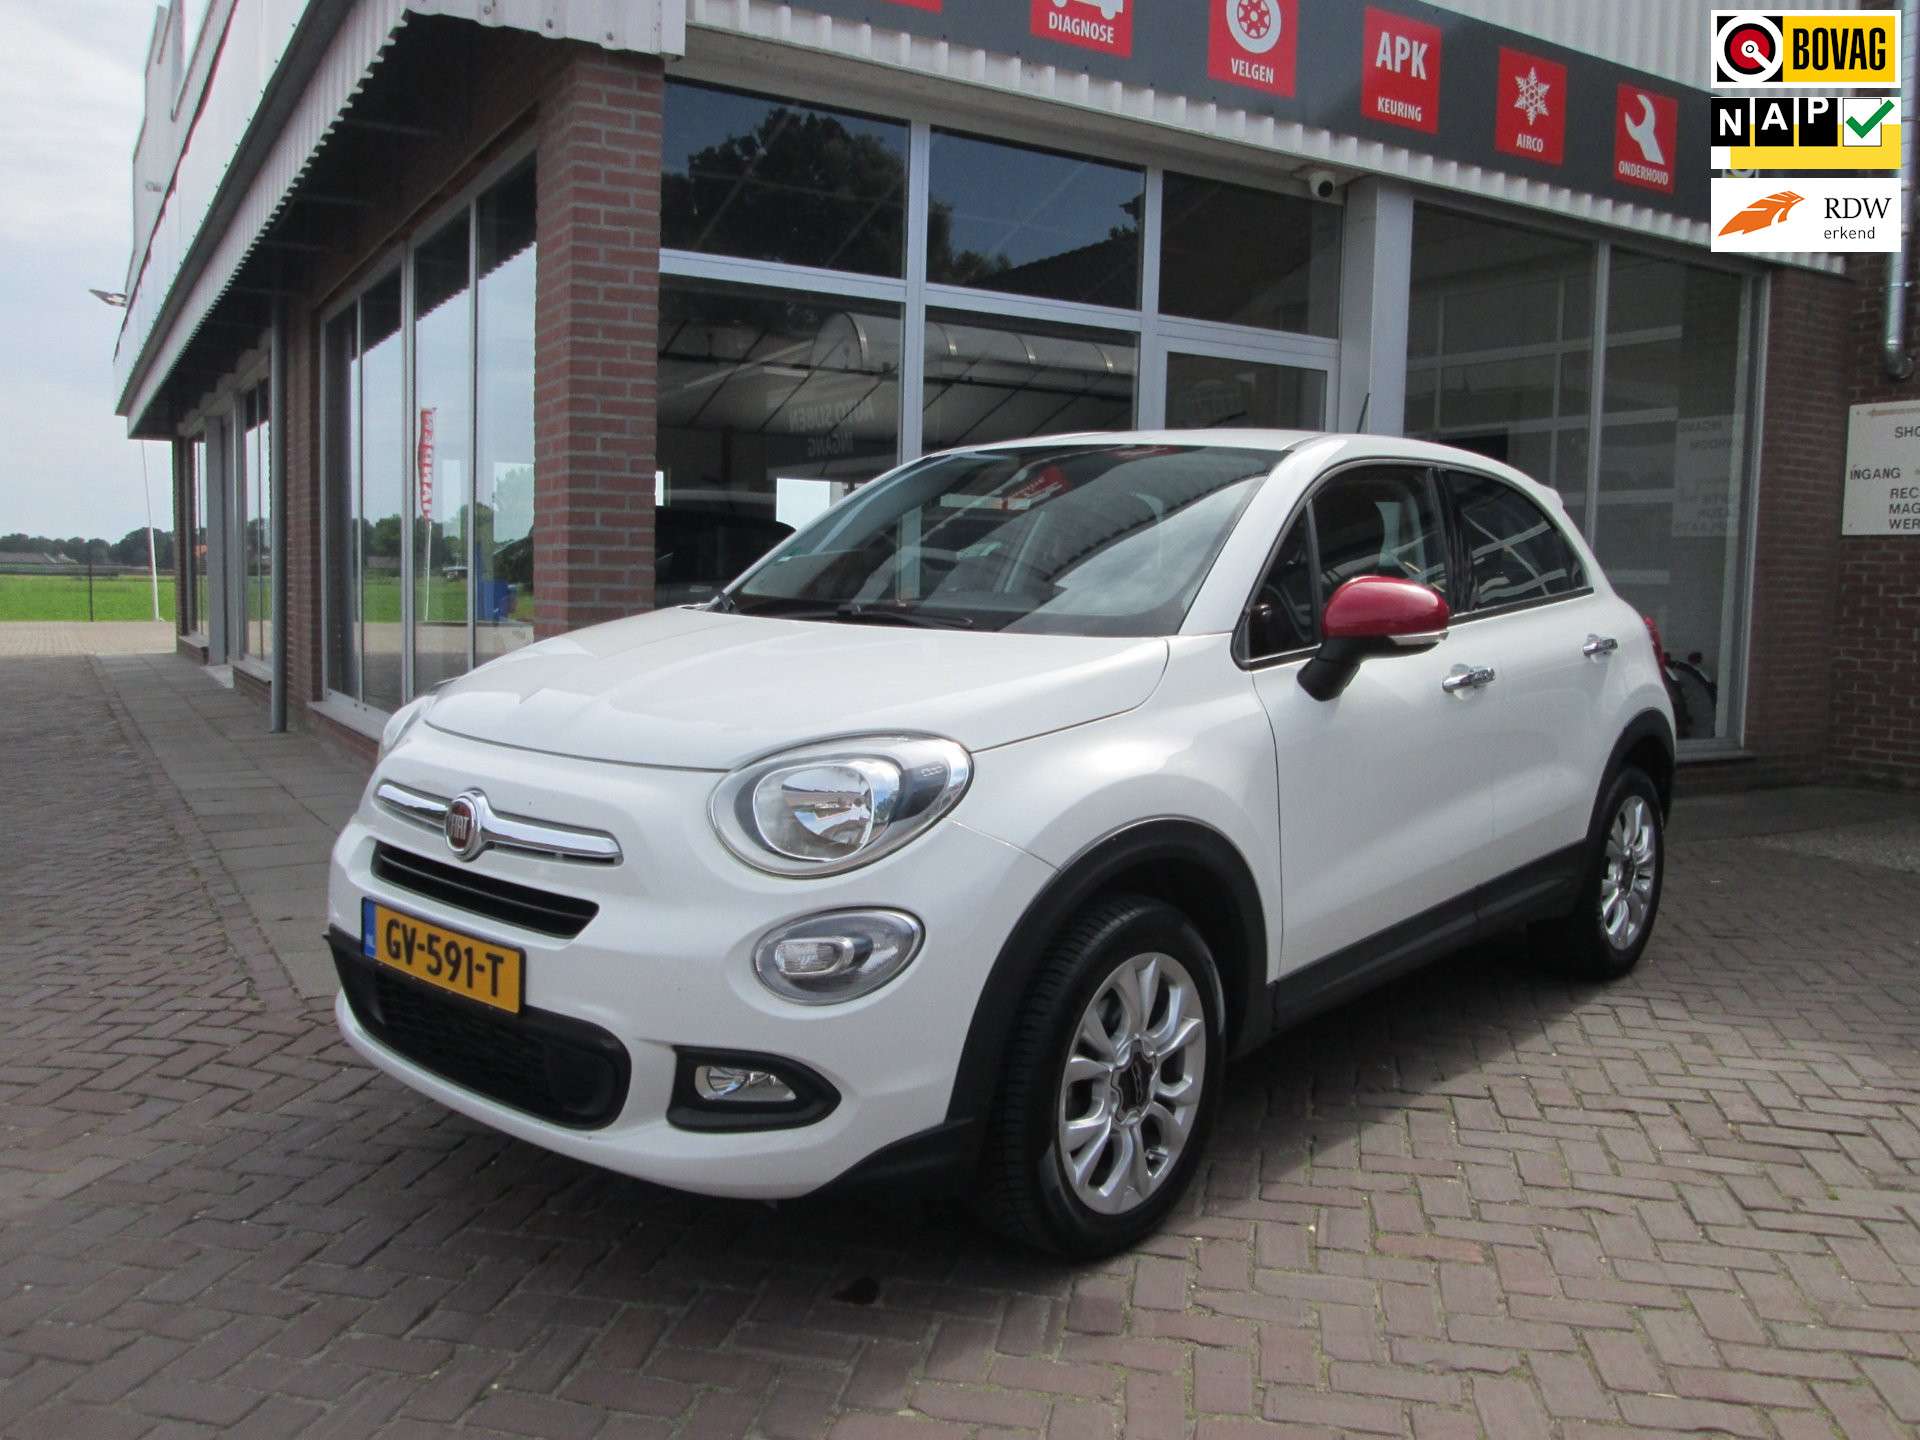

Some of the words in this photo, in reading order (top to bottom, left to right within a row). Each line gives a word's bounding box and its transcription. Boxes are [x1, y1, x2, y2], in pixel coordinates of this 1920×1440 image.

[1048, 12, 1114, 44] DIAGNOSE
[1376, 32, 1428, 80] APK
[1231, 58, 1274, 84] VELGEN
[1377, 97, 1422, 123] KEURING
[1516, 133, 1544, 153] AIRCO
[1618, 160, 1669, 186] ONDERHOUD
[1850, 467, 1901, 480] INGANG
[1889, 502, 1920, 514] MAG
[1889, 518, 1920, 530] WER
[452, 815, 469, 840] FIAT
[387, 919, 504, 997] GV-591-T
